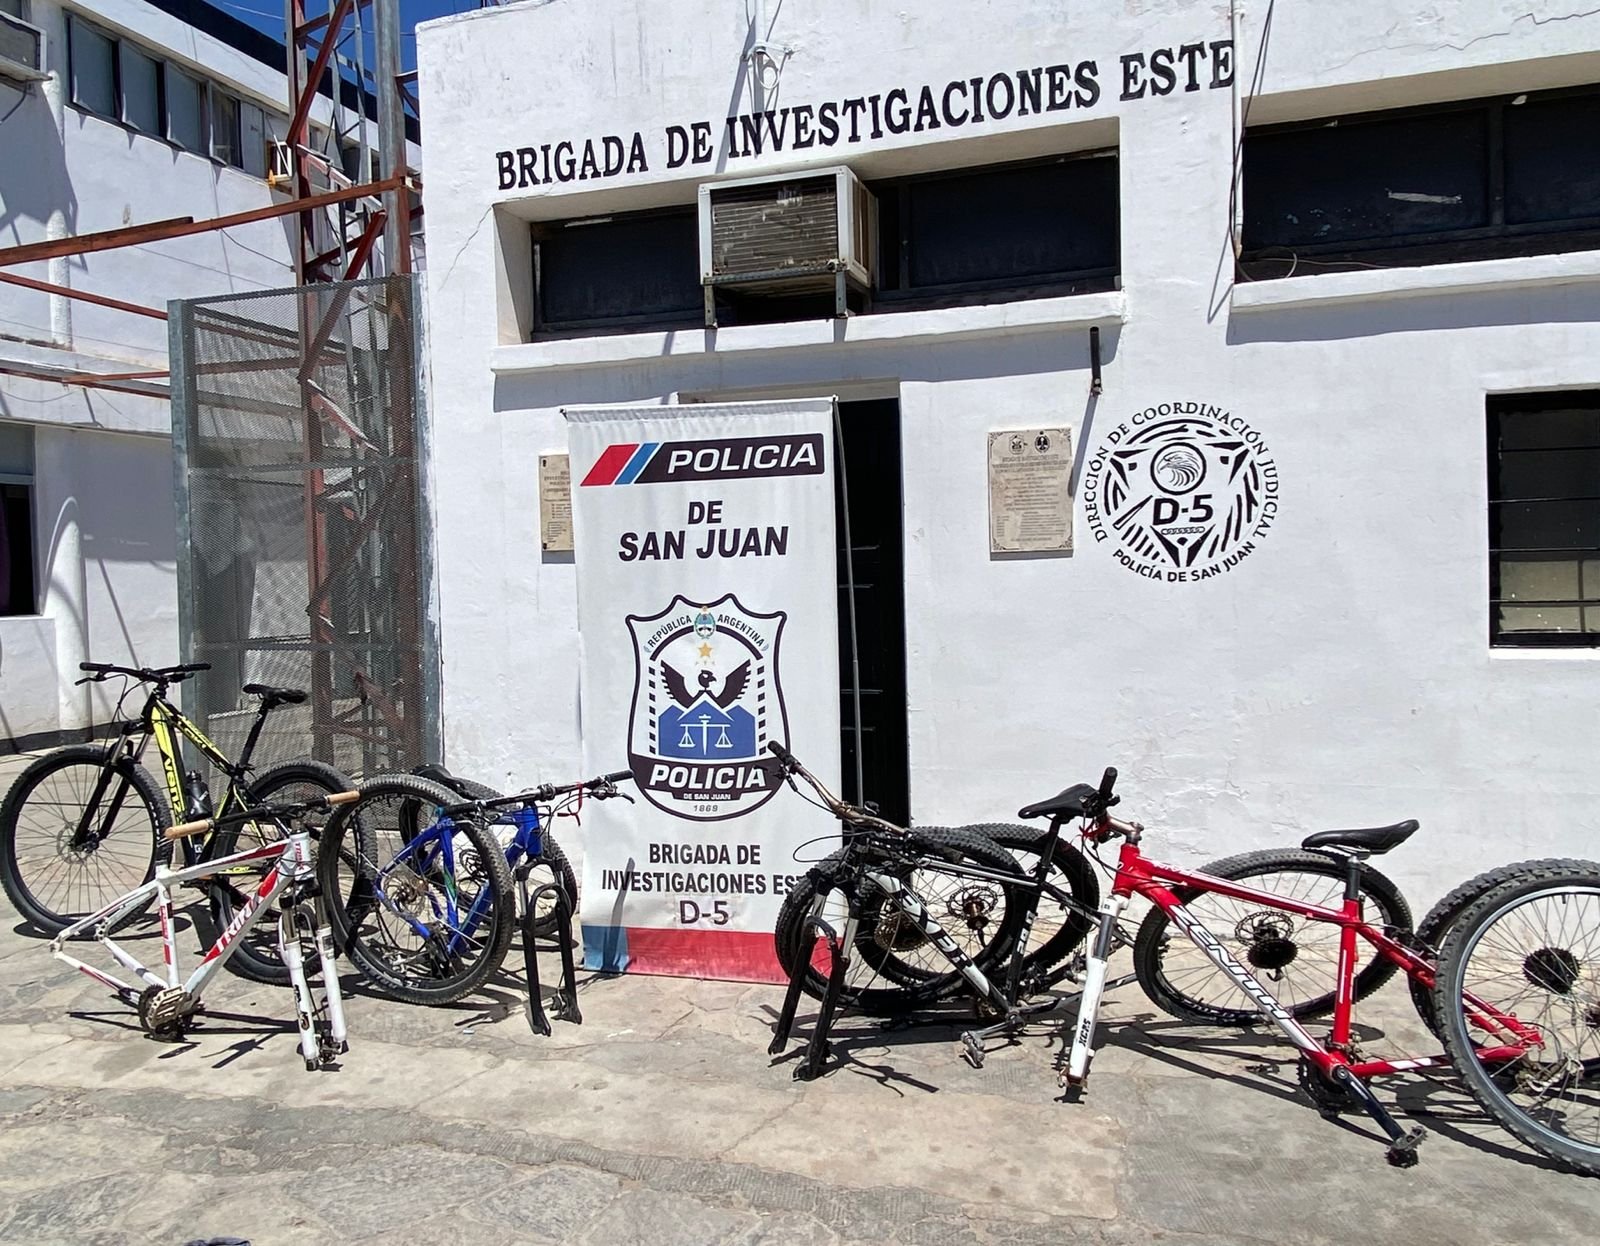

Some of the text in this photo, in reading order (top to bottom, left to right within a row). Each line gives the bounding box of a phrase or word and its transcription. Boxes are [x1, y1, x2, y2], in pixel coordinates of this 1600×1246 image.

[496, 39, 1237, 190] BRIGADA DE INVESTIGACIONES ESTE
[667, 442, 817, 474] POLICIA
[1084, 446, 1109, 543] DIRECCIÓN
[1107, 423, 1130, 445] DE
[1132, 402, 1269, 456] COORDINACIÓN
[1253, 459, 1279, 539] JUDICIAL
[688, 500, 723, 525] DE
[1152, 494, 1214, 526] D-5
[619, 526, 789, 562] SAN JUAN
[1112, 541, 1256, 582] POLICÍA DE SAN JUAN
[648, 614, 765, 647] REPÚBLICA ARGENTINA
[649, 763, 766, 790] POLICIA
[693, 804, 719, 812] 1869
[649, 843, 761, 865] BRIGADA DE
[602, 869, 767, 895] INVESTIGACIONES
[679, 900, 730, 925] D-5
[1168, 904, 1293, 1019] ZENITH
